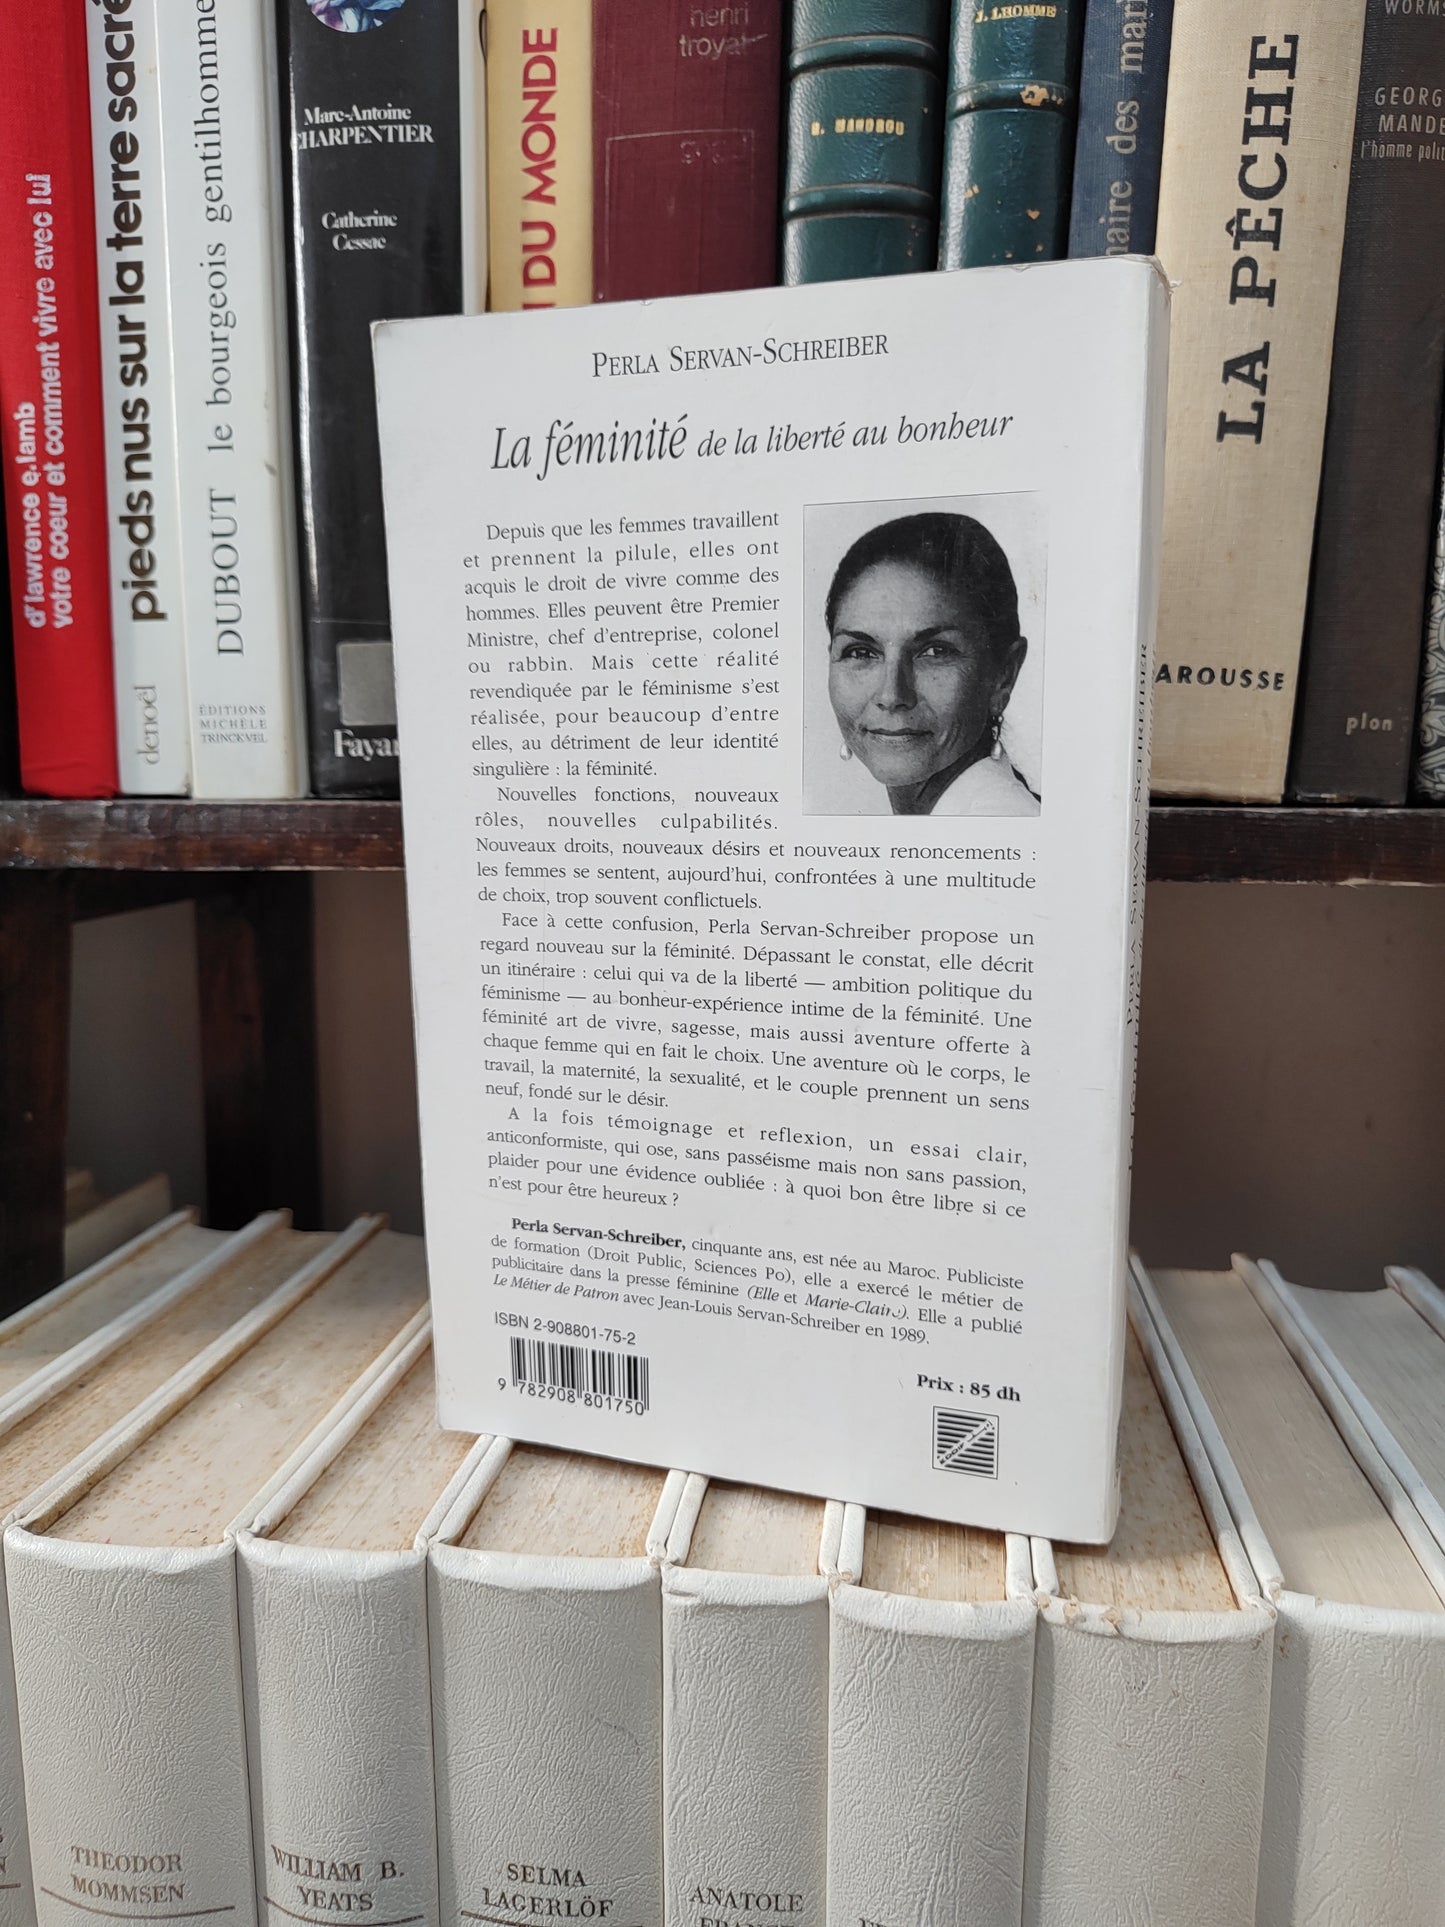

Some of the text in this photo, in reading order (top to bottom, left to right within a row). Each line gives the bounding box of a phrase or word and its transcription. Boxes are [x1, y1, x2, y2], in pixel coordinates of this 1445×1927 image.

[690, 2, 749, 27] henri
[304, 103, 412, 125] Marc-Antoine
[521, 27, 558, 206] MONDE
[1106, 100, 1139, 154] des
[106, 131, 143, 251] terre
[321, 209, 398, 229] Catherine
[520, 221, 557, 288] DU
[1216, 34, 1300, 445] LA PÊCHE
[109, 261, 145, 306] la
[194, 0, 244, 656] DUBOUT le bourgeois gentilhomme
[118, 314, 148, 386] sur
[591, 335, 890, 378] PERLA SERVAN-SCHREIBER
[25, 173, 73, 629] votre coeur et comment vivre avec lui
[122, 397, 153, 481] nus
[490, 411, 1014, 481] La féminité de la liberté au bonheur
[487, 511, 780, 544] Depuis que les femmes travaillent
[22, 492, 45, 602] lawrence
[119, 489, 167, 621] pieds
[463, 541, 779, 572] et prennent la pilule, elles ont
[465, 567, 780, 599] acquis le droit de vivre comme des
[466, 596, 781, 622] hommes. Elles peuvent être Premier
[469, 650, 779, 674] ou rabbin. Mais cette réalité
[134, 685, 160, 765] denoël
[199, 704, 267, 716] ÉDITIONS
[200, 718, 268, 730] MICHÈLE
[1346, 712, 1394, 735] plon
[497, 786, 780, 806] Nouvelles fonctions, nouveaux
[475, 812, 778, 834] rôles, nouvelles culpabilités.
[478, 887, 762, 909] de choix, trop souvent conflictuels.
[502, 913, 1035, 948] Face à cette confusion, Perla Servan-Schreiber propose un
[486, 1082, 669, 1108] neuf, fondé sur le désir.
[508, 1107, 1027, 1168] A la fois témoignage et reflexion, un essai clair,
[512, 1218, 1024, 1290] Perla Servan-Schreiber, cinquante ans, est née au Maroc. Publiciste
[495, 1312, 637, 1345] ISBN 2-908801-75-2
[497, 1377, 645, 1416] 9 782908 801750
[917, 1374, 954, 1392] Prix
[970, 1382, 991, 1399] 85
[996, 1385, 1021, 1402] dh
[70, 1845, 183, 1873] THEODOR
[270, 1844, 404, 1881] WILLIAM B.
[506, 1863, 587, 1888] SELMA
[70, 1874, 185, 1903] MOMMSEN
[297, 1886, 374, 1911] YEATS
[481, 1888, 614, 1918] LAGERLÖF
[688, 1887, 804, 1913] ANATOLE
